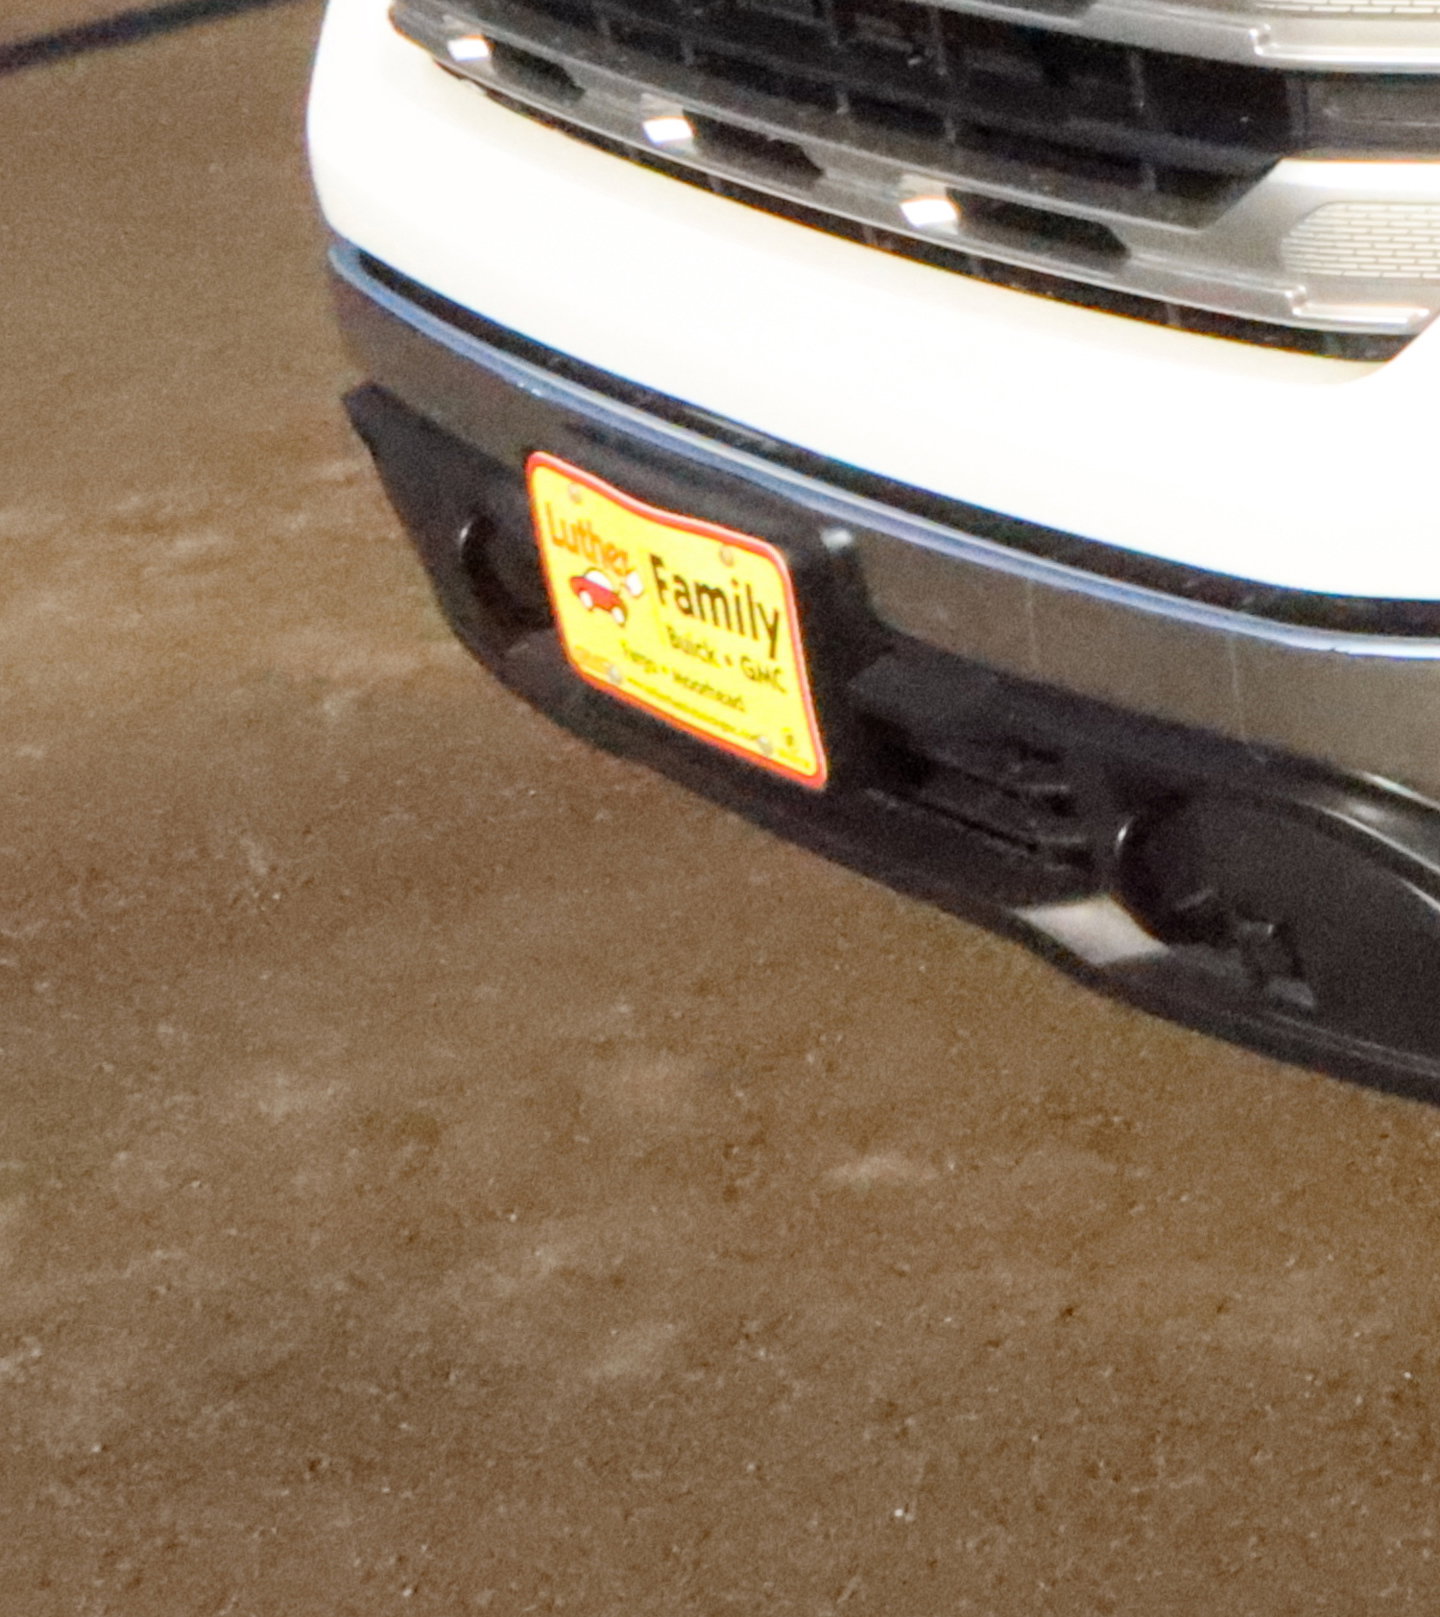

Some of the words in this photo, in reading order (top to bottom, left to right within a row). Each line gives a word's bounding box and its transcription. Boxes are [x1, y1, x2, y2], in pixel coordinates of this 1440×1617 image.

[544, 500, 637, 577] Luther
[650, 553, 779, 660] Family
[740, 655, 788, 693] GMC
